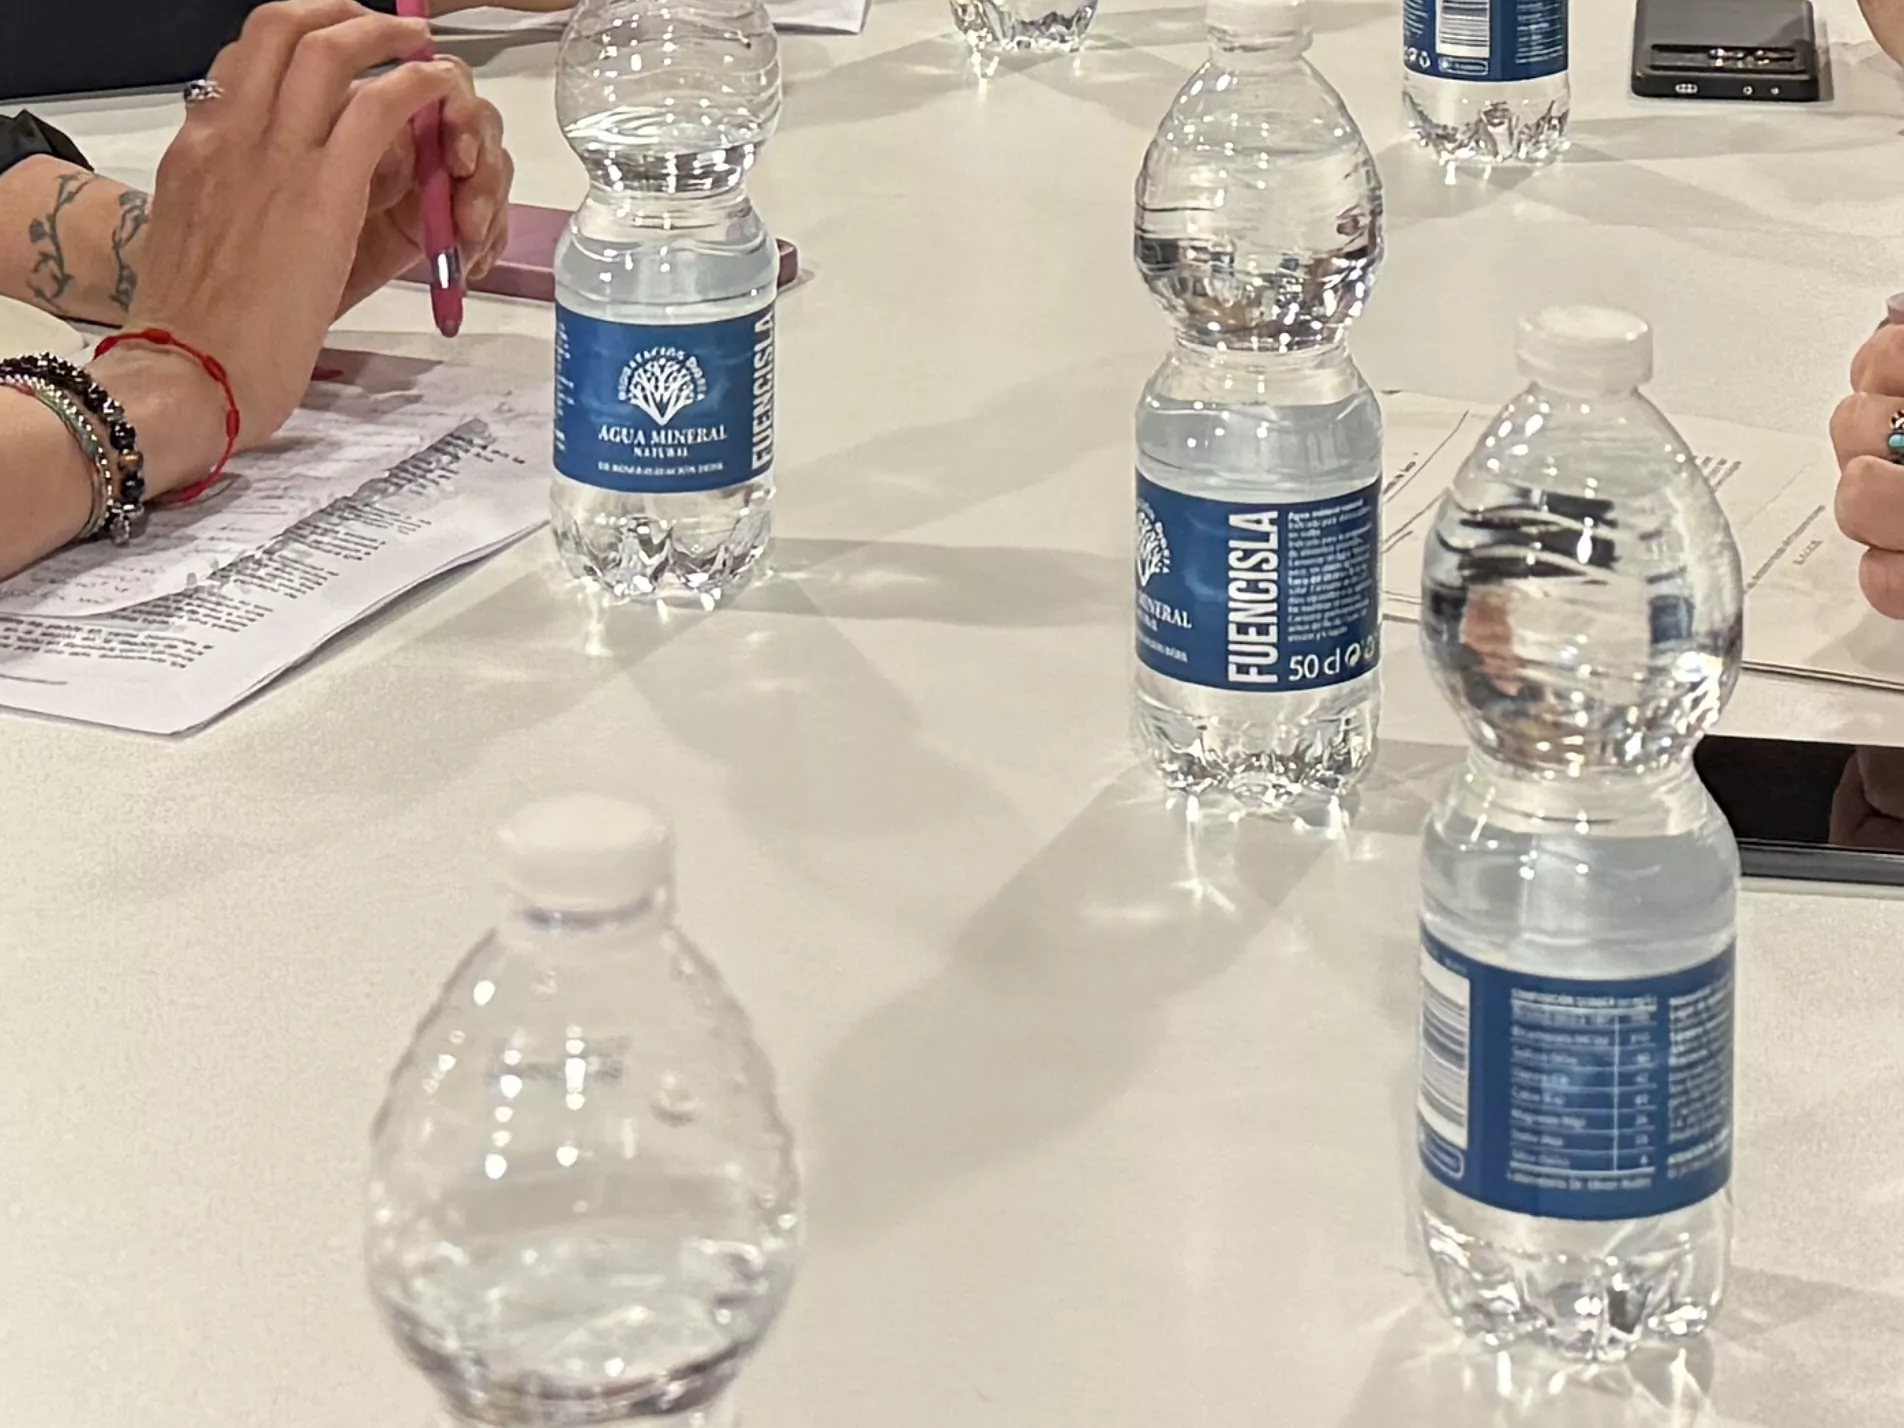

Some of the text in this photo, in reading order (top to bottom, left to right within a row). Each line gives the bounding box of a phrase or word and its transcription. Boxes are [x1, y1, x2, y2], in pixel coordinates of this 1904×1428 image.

[598, 424, 728, 445] AGUA MINERAL
[751, 311, 775, 471] FUENCISLA
[1227, 509, 1279, 684] FUENCISLA
[1288, 646, 1341, 682] 50 cl
